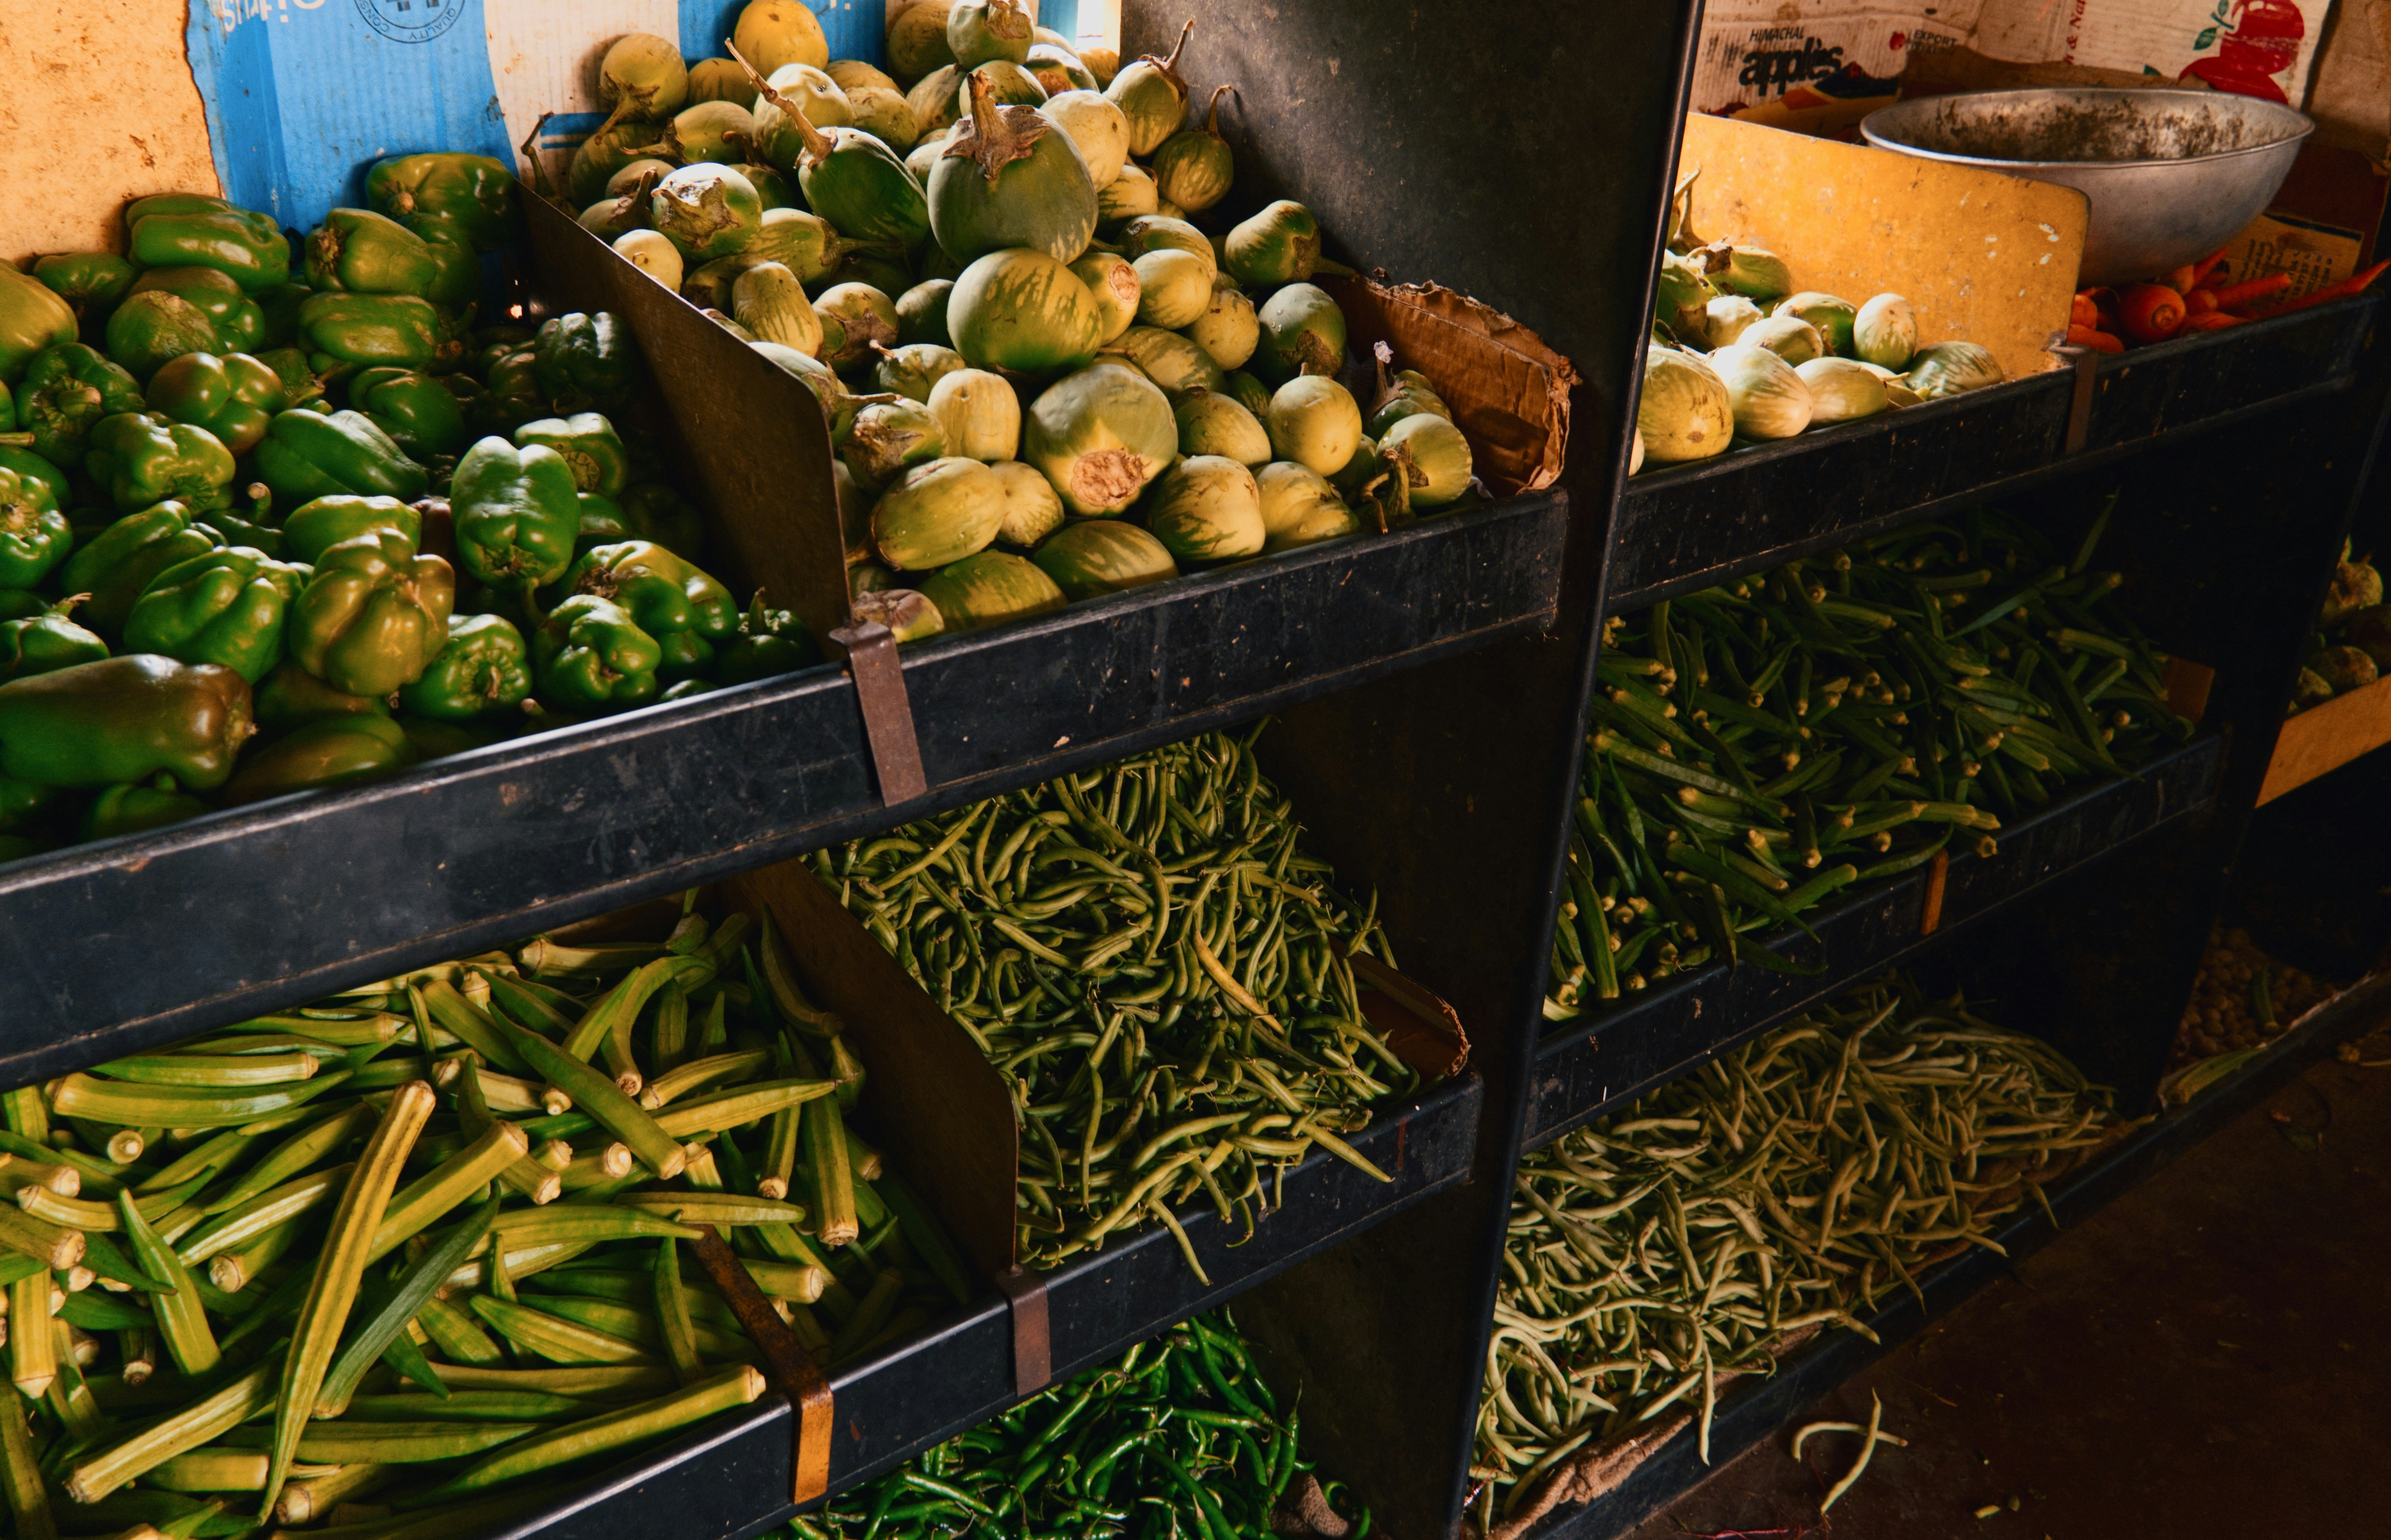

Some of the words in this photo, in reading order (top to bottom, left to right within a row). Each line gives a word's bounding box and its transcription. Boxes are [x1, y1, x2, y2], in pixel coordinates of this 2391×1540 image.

[359, 0, 390, 33] CONS
[408, 8, 456, 40] QUALITY
[1750, 27, 1805, 42] HIMACHAL
[1914, 30, 1957, 46] EXPORT
